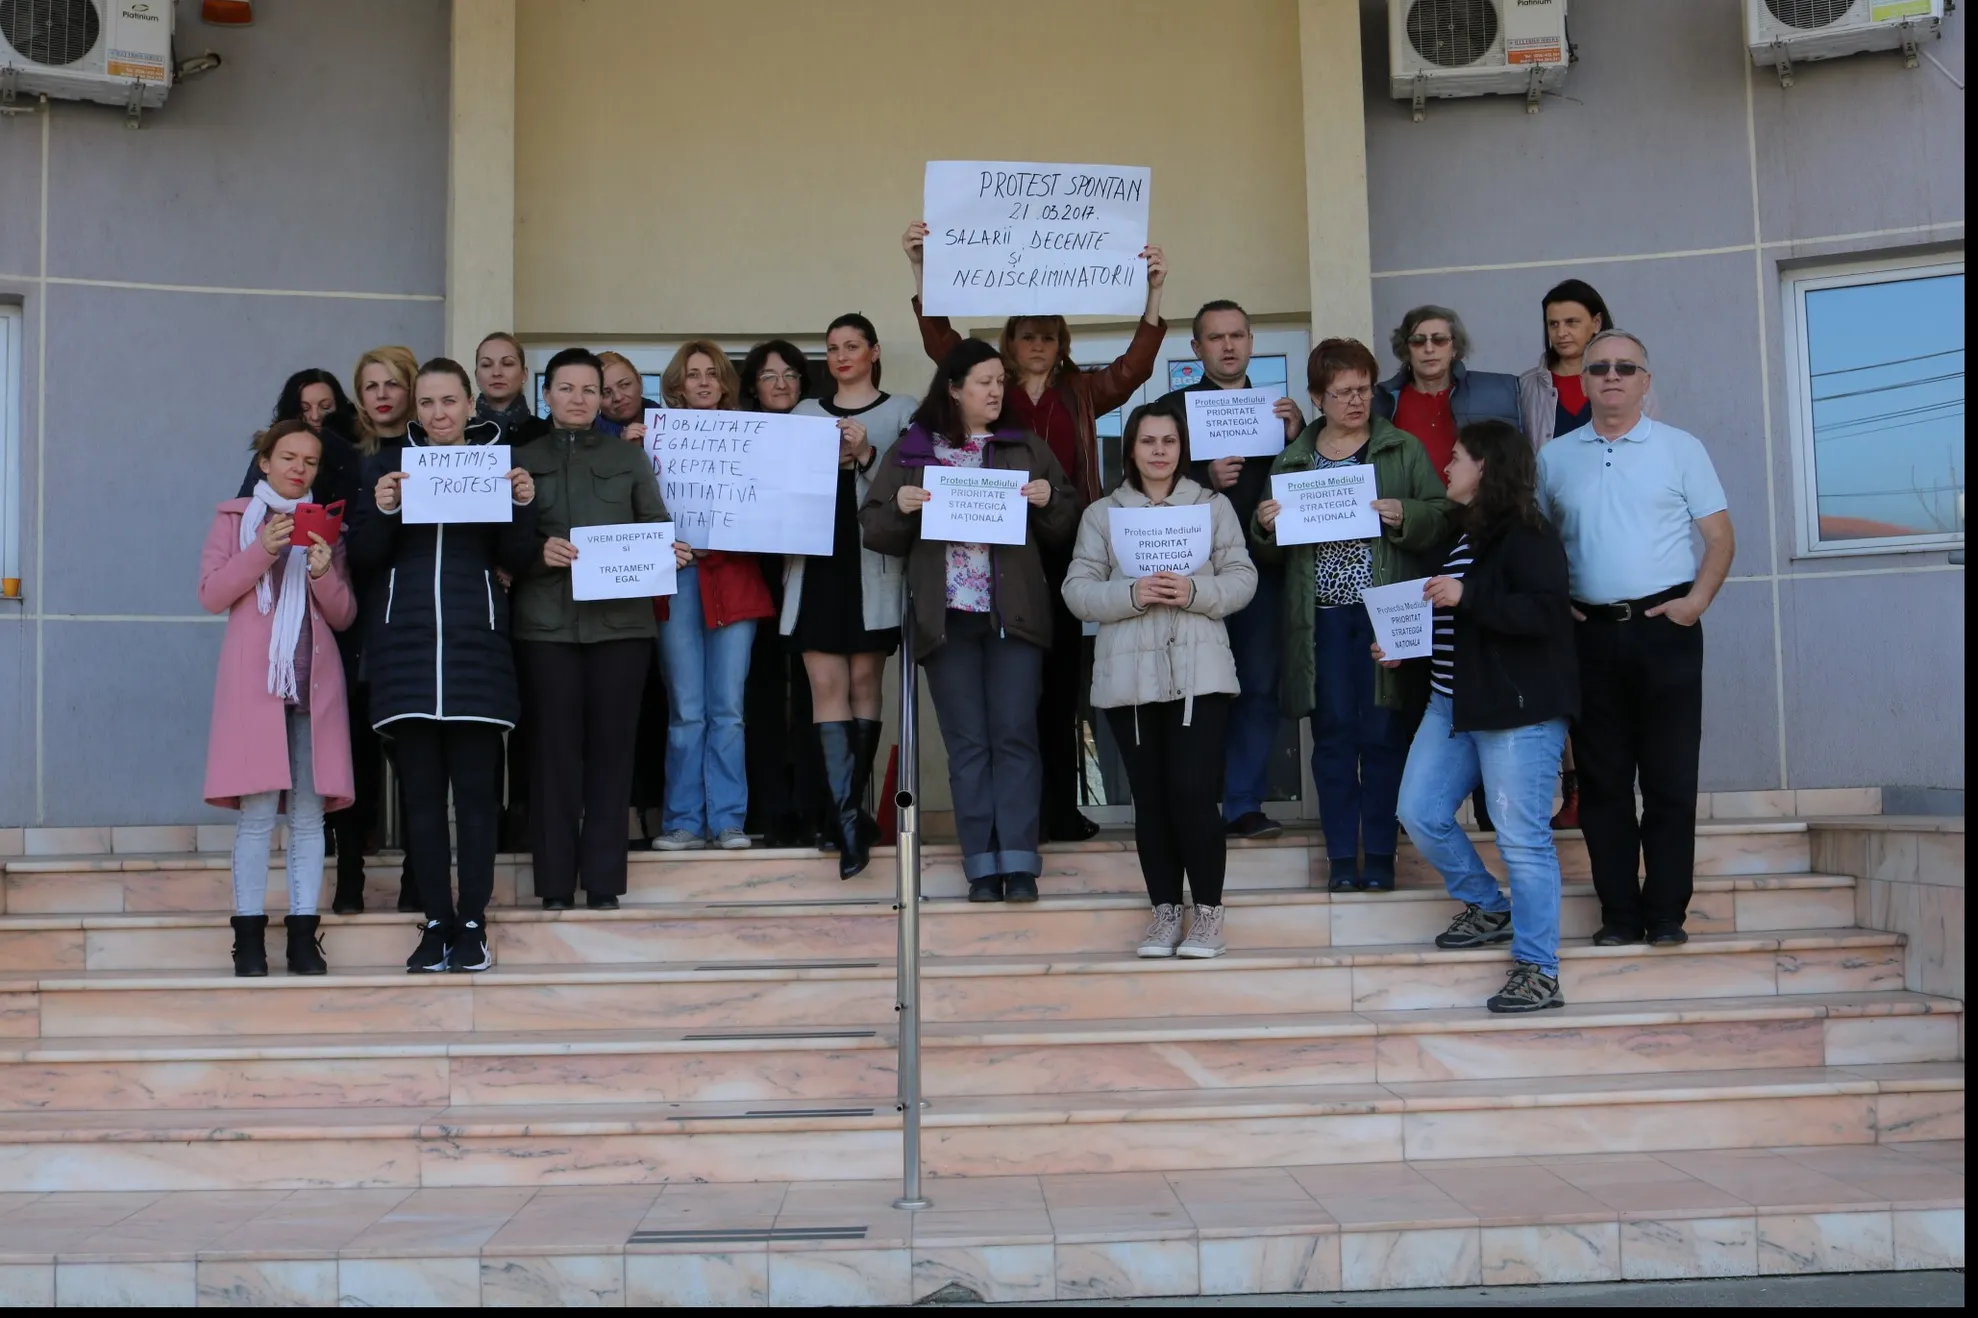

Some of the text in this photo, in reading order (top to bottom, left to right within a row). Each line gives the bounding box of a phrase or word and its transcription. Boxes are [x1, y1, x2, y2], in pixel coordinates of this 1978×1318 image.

[122, 11, 159, 22] Platinium
[980, 171, 1142, 201] PROTEST SPONTAN
[1029, 231, 1110, 250] DECENTE
[953, 260, 1136, 288] NEDISCRIMINATORII
[1232, 396, 1266, 405] Mediului
[1206, 407, 1256, 417] PRIORITATE
[653, 414, 769, 434] MOBILITATE
[653, 433, 753, 453] EGALITATE
[653, 455, 743, 476] DREPTATE
[430, 476, 510, 496] PROTEST
[981, 478, 1018, 488] Mediului
[1328, 475, 1365, 487] Mediului
[666, 478, 758, 504] NITIATIVĂ
[951, 489, 1006, 499] PRIORITATE
[1300, 487, 1355, 501] PRIORITATE
[1165, 525, 1202, 536] Mediului
[587, 531, 664, 543] VREM DREPTATE
[1139, 538, 1188, 548] PRIORITAT
[600, 563, 656, 574] TRATAMENT
[615, 575, 641, 583] EGAL
[1391, 613, 1421, 624] PRIORITAT
